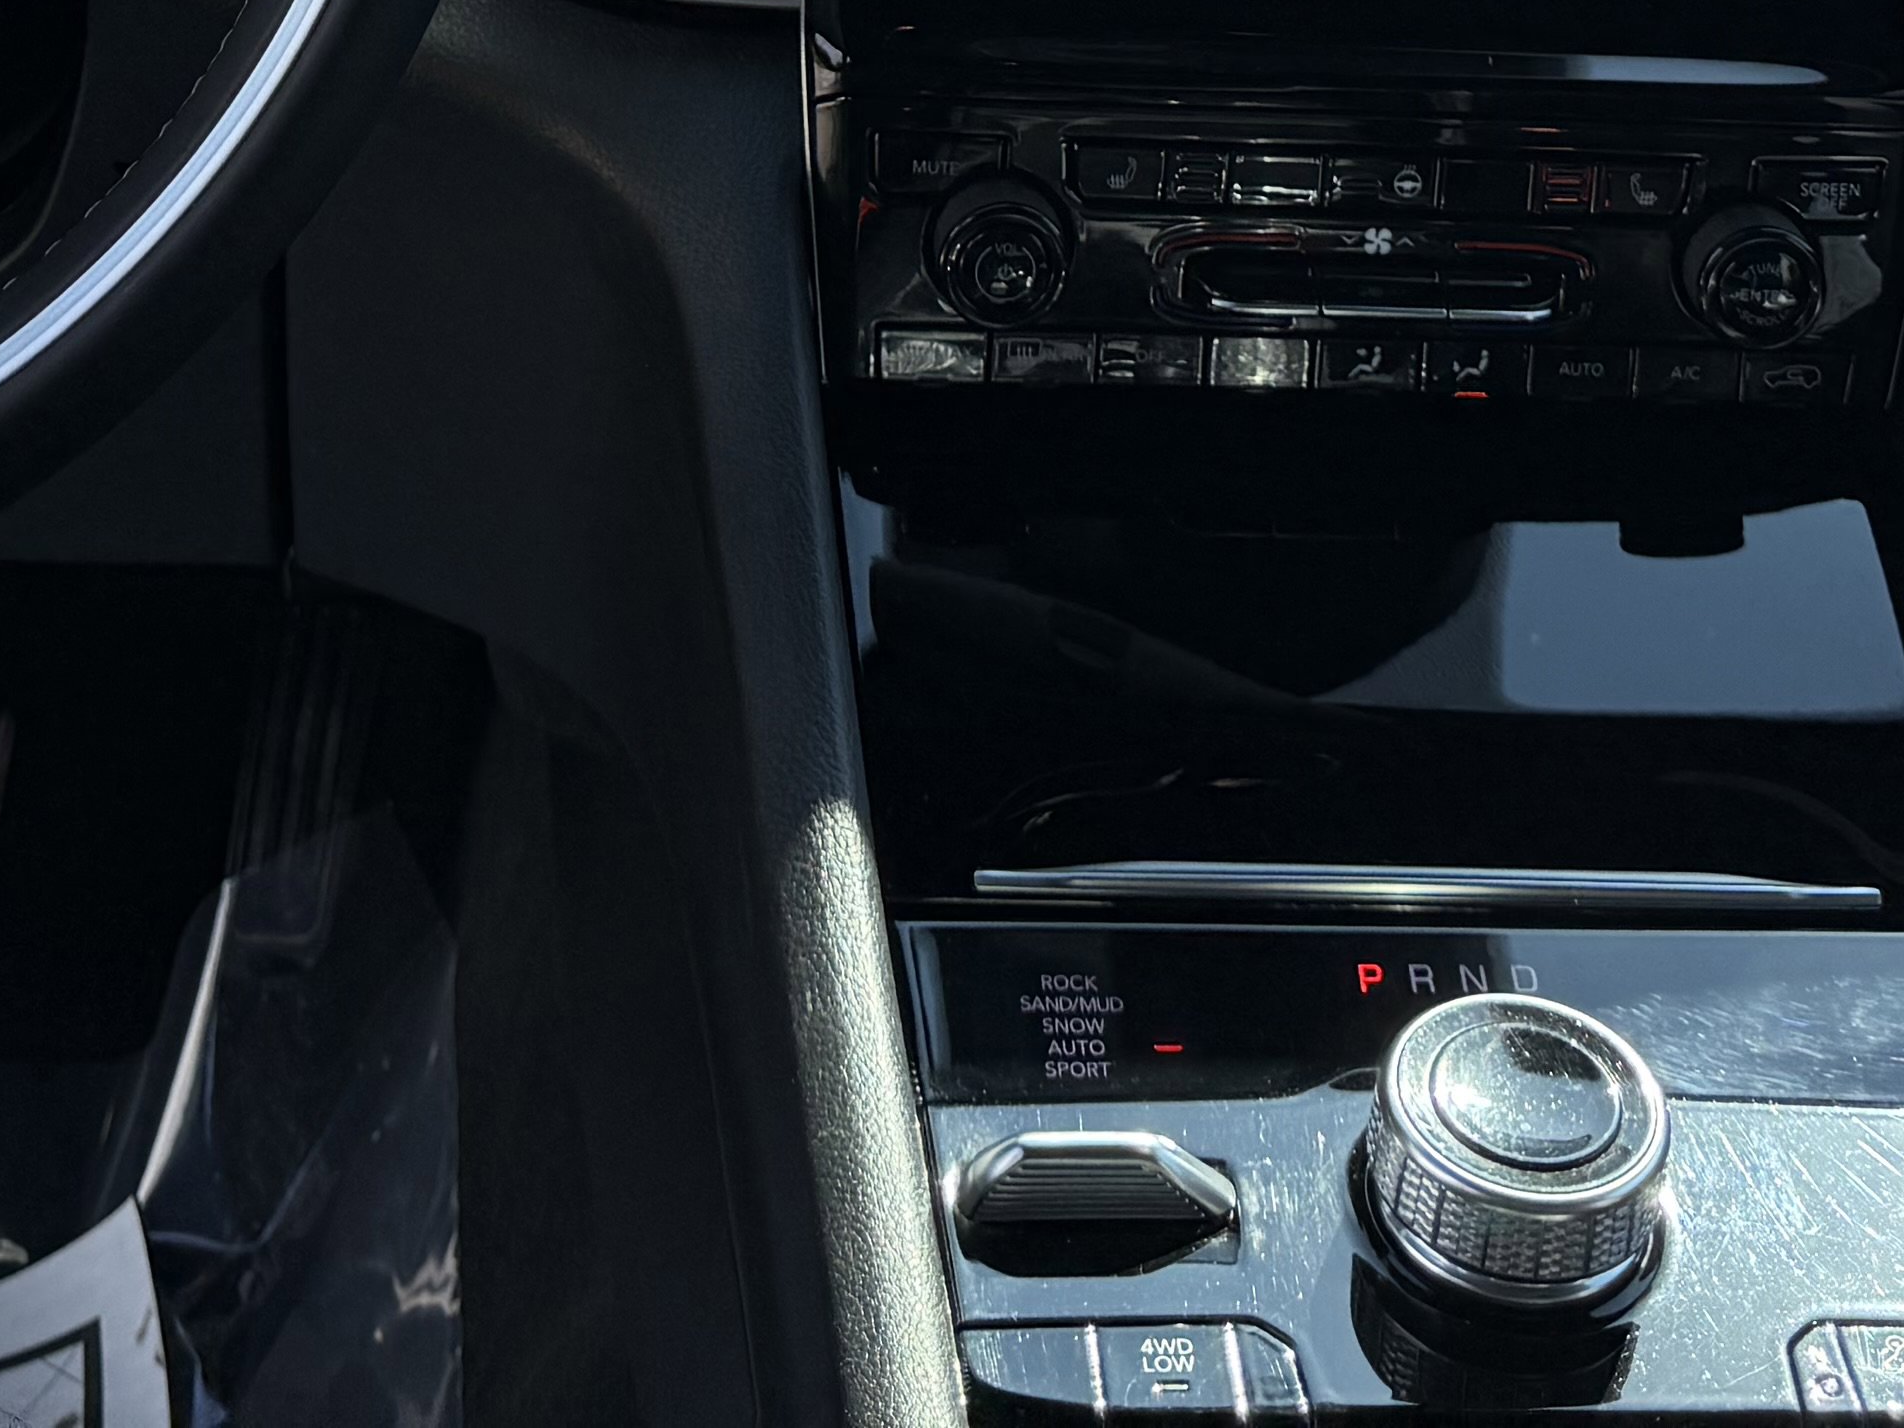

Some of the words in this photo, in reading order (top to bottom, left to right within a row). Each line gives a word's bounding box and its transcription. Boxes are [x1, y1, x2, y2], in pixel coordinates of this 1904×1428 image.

[912, 159, 960, 176] MUTE
[1800, 181, 1862, 199] SCREEN
[1135, 347, 1165, 364] OFF
[1558, 360, 1605, 377] AUTO
[1669, 364, 1701, 381] A/C
[1040, 974, 1098, 992] ROCK
[1358, 963, 1385, 994] P
[1409, 964, 1437, 994] R
[1460, 964, 1490, 994] N
[1512, 964, 1540, 993] D
[1020, 994, 1125, 1014] SAND/MUD
[1042, 1016, 1105, 1035] SNOW
[1048, 1039, 1106, 1057] AUTO
[1044, 1061, 1112, 1079] SPORT
[1140, 1337, 1194, 1355] 4WD
[1142, 1354, 1195, 1373] LOW
